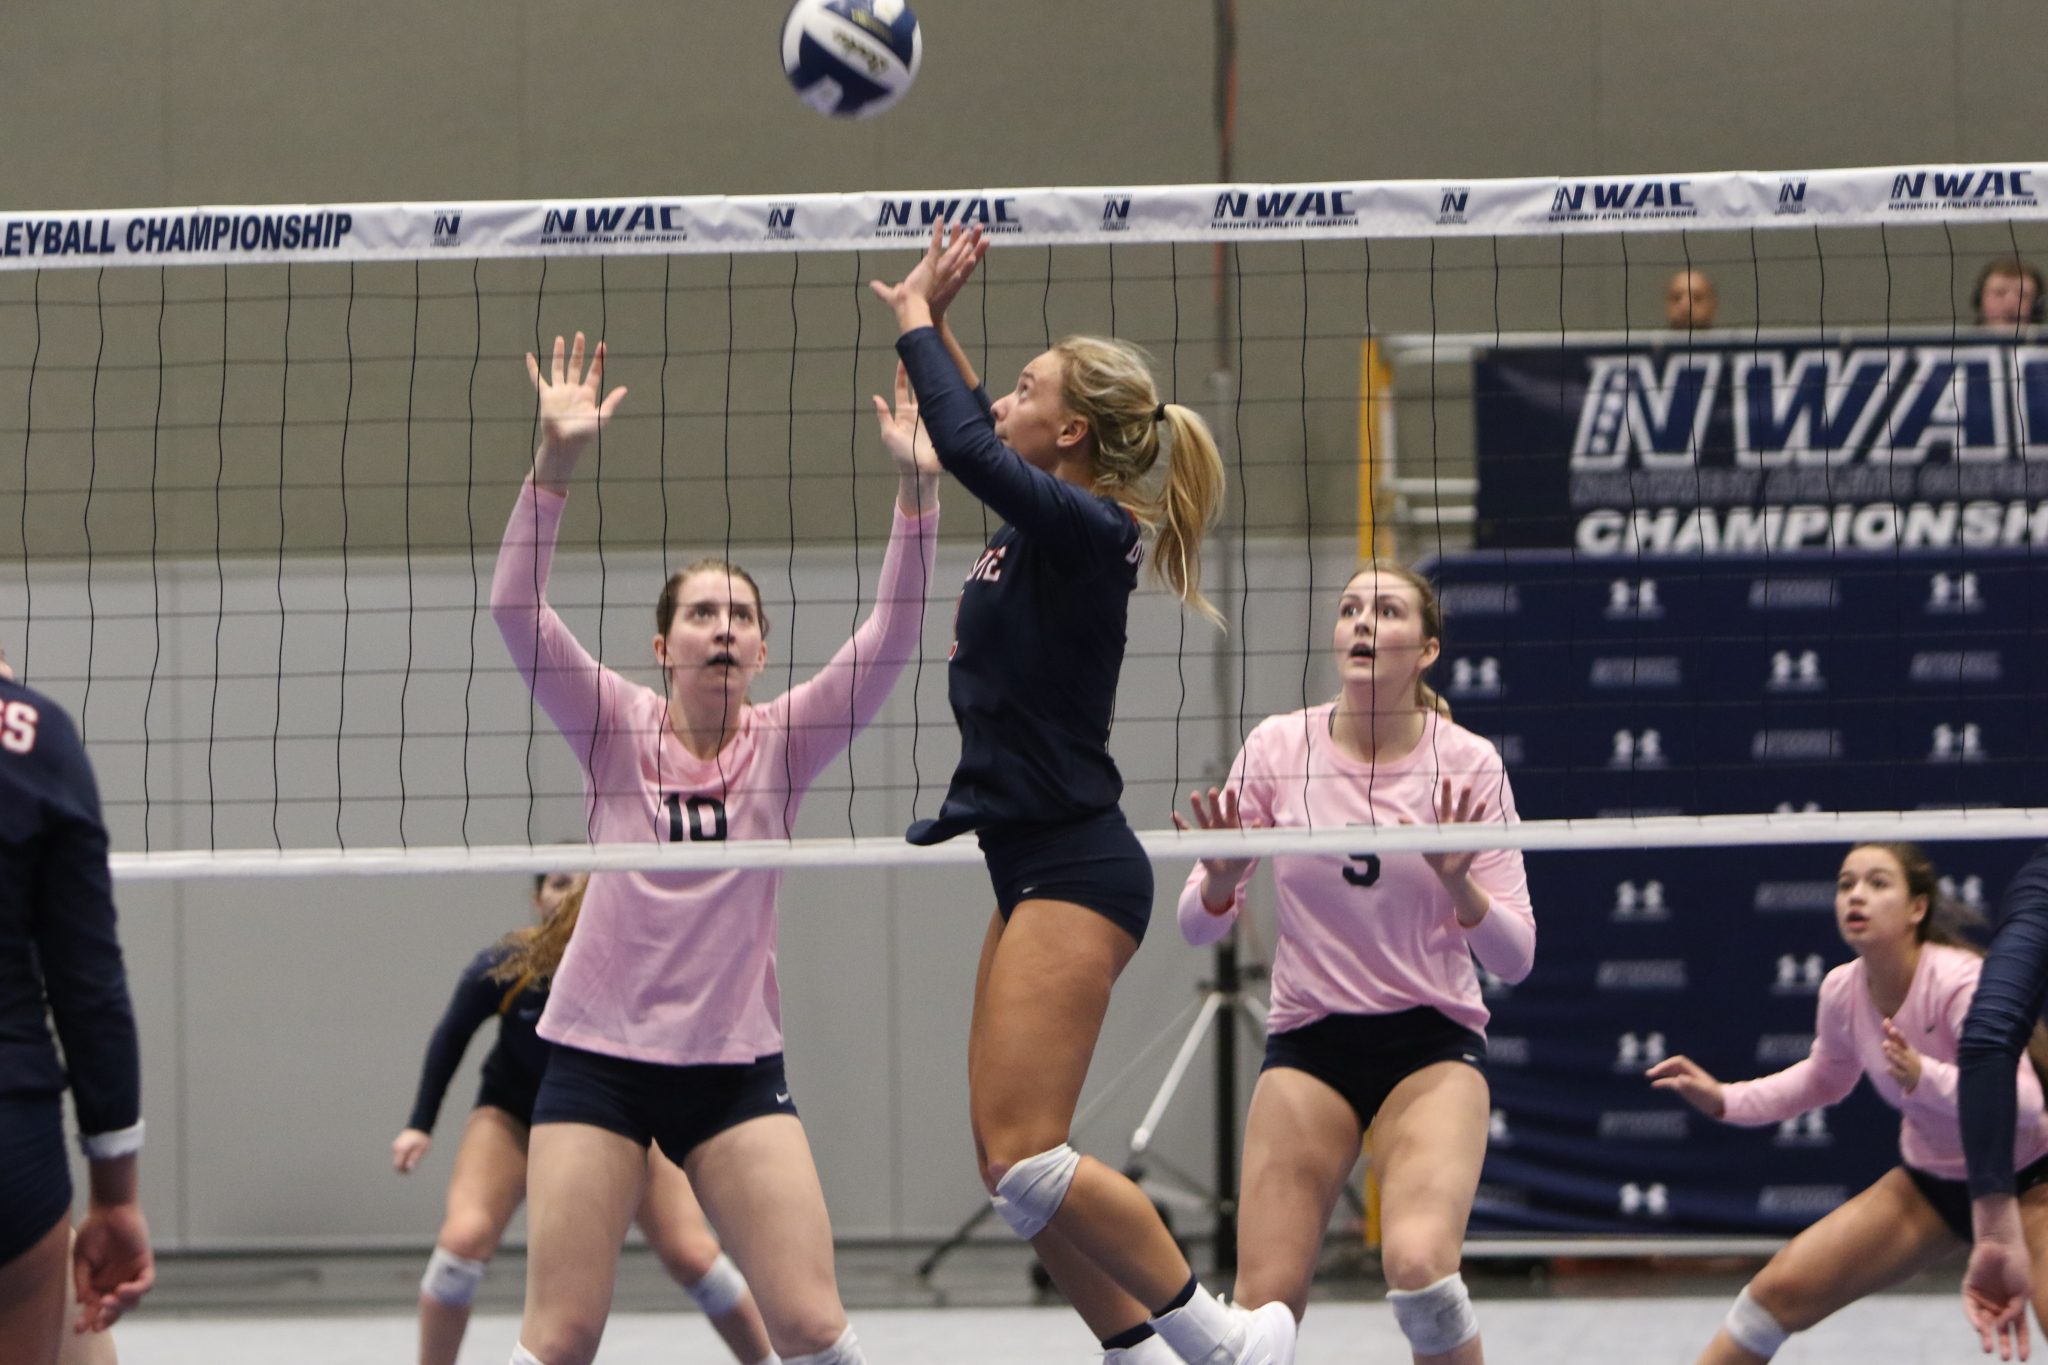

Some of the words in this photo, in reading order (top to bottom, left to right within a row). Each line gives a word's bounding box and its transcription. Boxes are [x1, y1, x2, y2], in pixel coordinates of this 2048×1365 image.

[1551, 181, 1694, 212] NWAC
[1891, 170, 2034, 199] NWAC
[543, 204, 684, 234] NWAC
[878, 196, 1019, 226] NWAC
[1214, 190, 1355, 219] NWAC
[0, 219, 116, 257] EYBALL
[126, 213, 352, 253] CHAMPIONSHIP
[0, 700, 39, 754] S
[663, 792, 727, 842] 10
